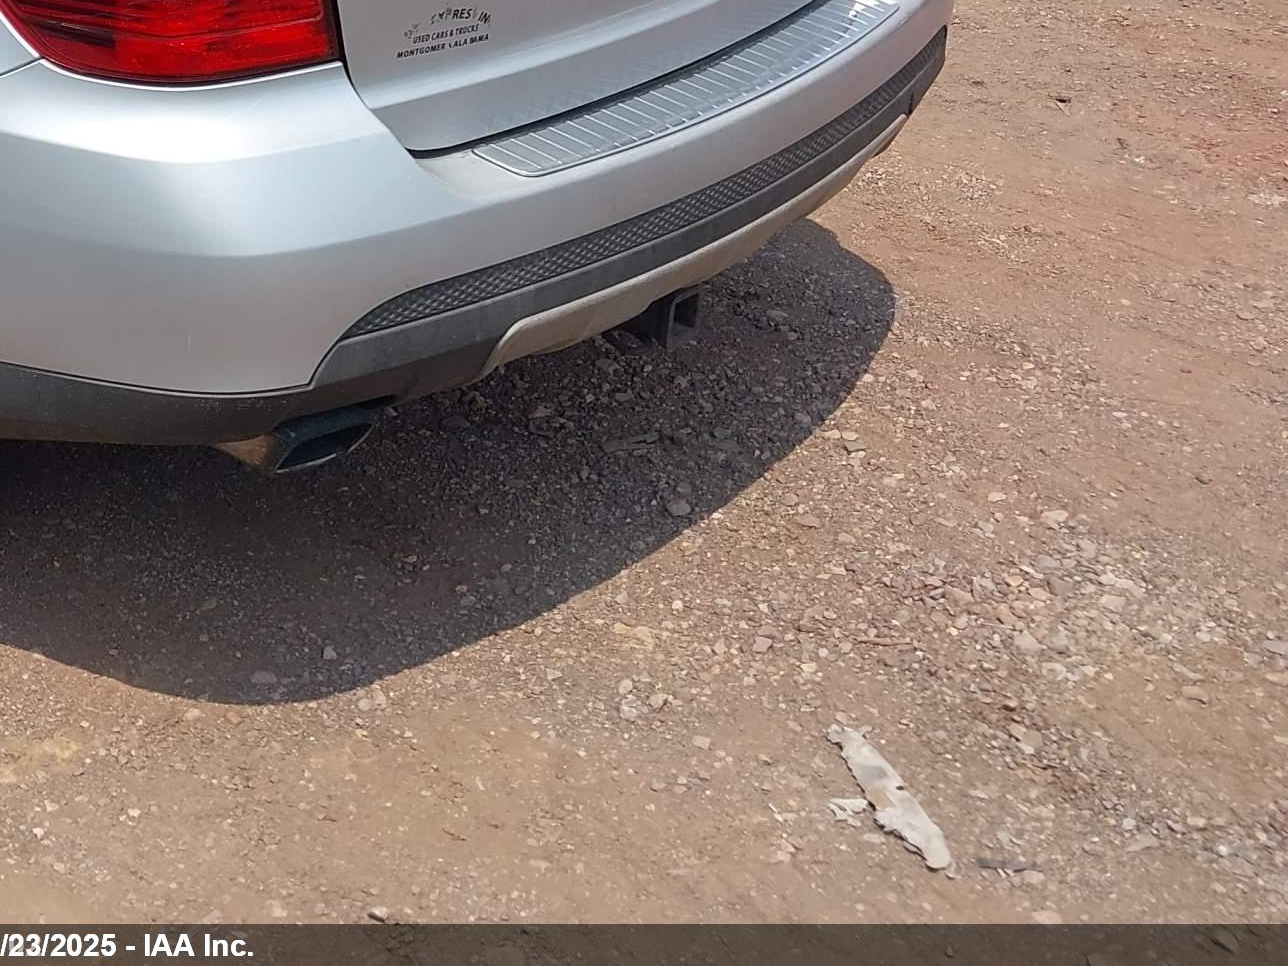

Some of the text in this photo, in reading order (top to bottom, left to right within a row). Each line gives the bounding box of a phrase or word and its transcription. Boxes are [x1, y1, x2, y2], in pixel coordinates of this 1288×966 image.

[412, 33, 430, 44] USED
[431, 29, 449, 41] CARS
[455, 23, 479, 36] TRUCKS
